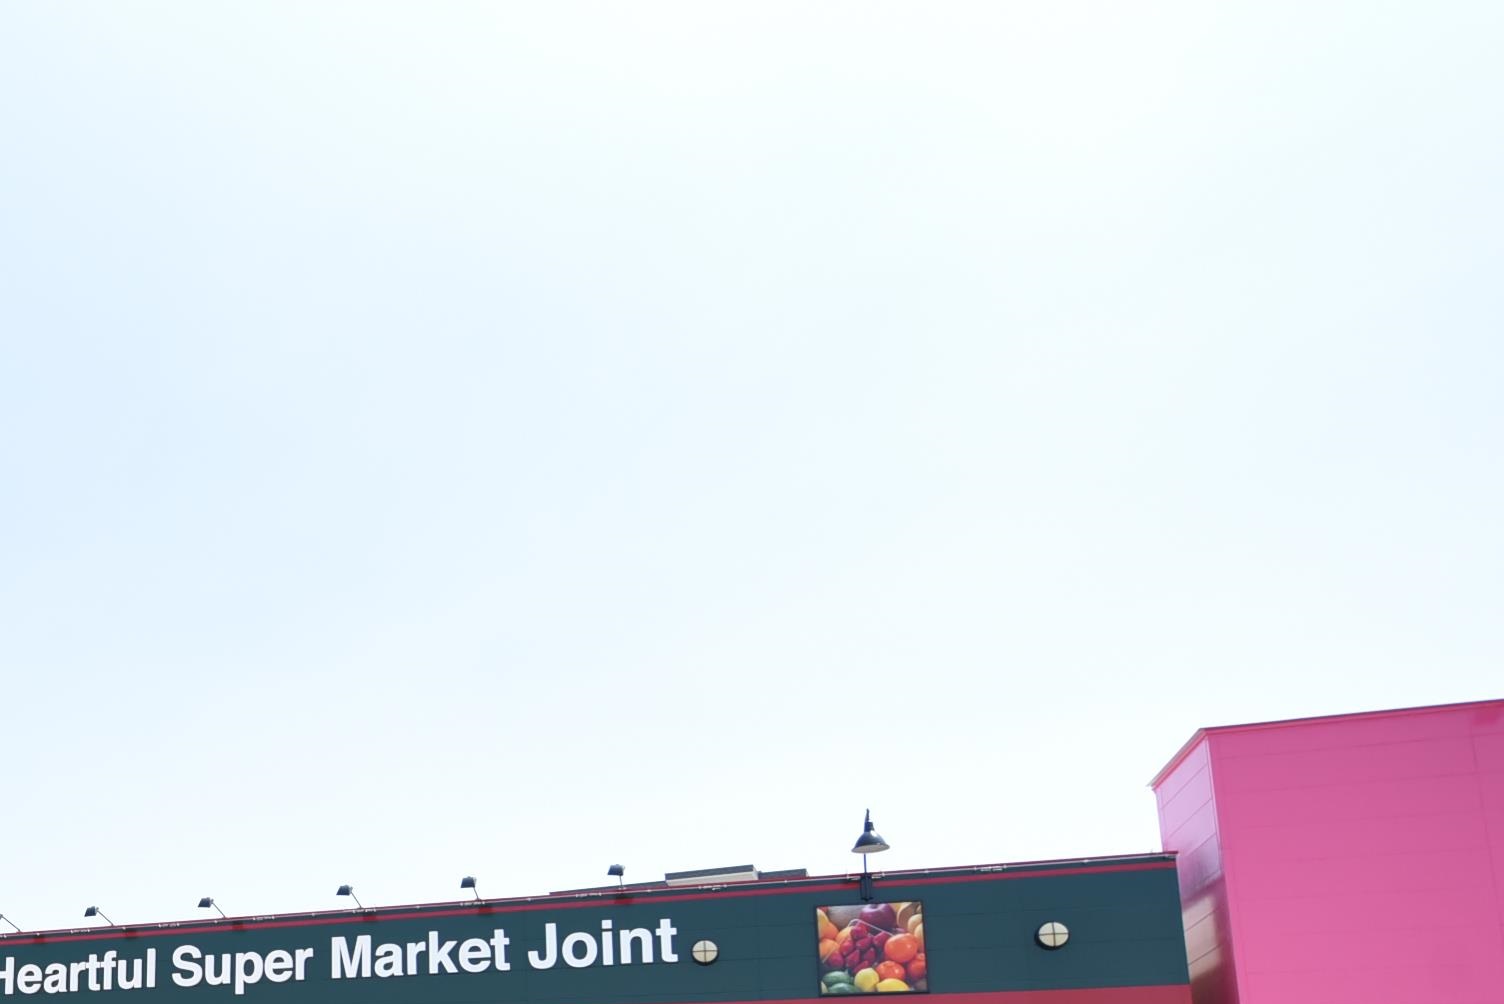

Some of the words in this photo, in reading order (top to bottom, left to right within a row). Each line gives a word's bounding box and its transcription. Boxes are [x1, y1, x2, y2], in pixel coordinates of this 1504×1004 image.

[171, 943, 314, 995] Super
[331, 928, 511, 979] Market
[527, 918, 678, 969] Joint
